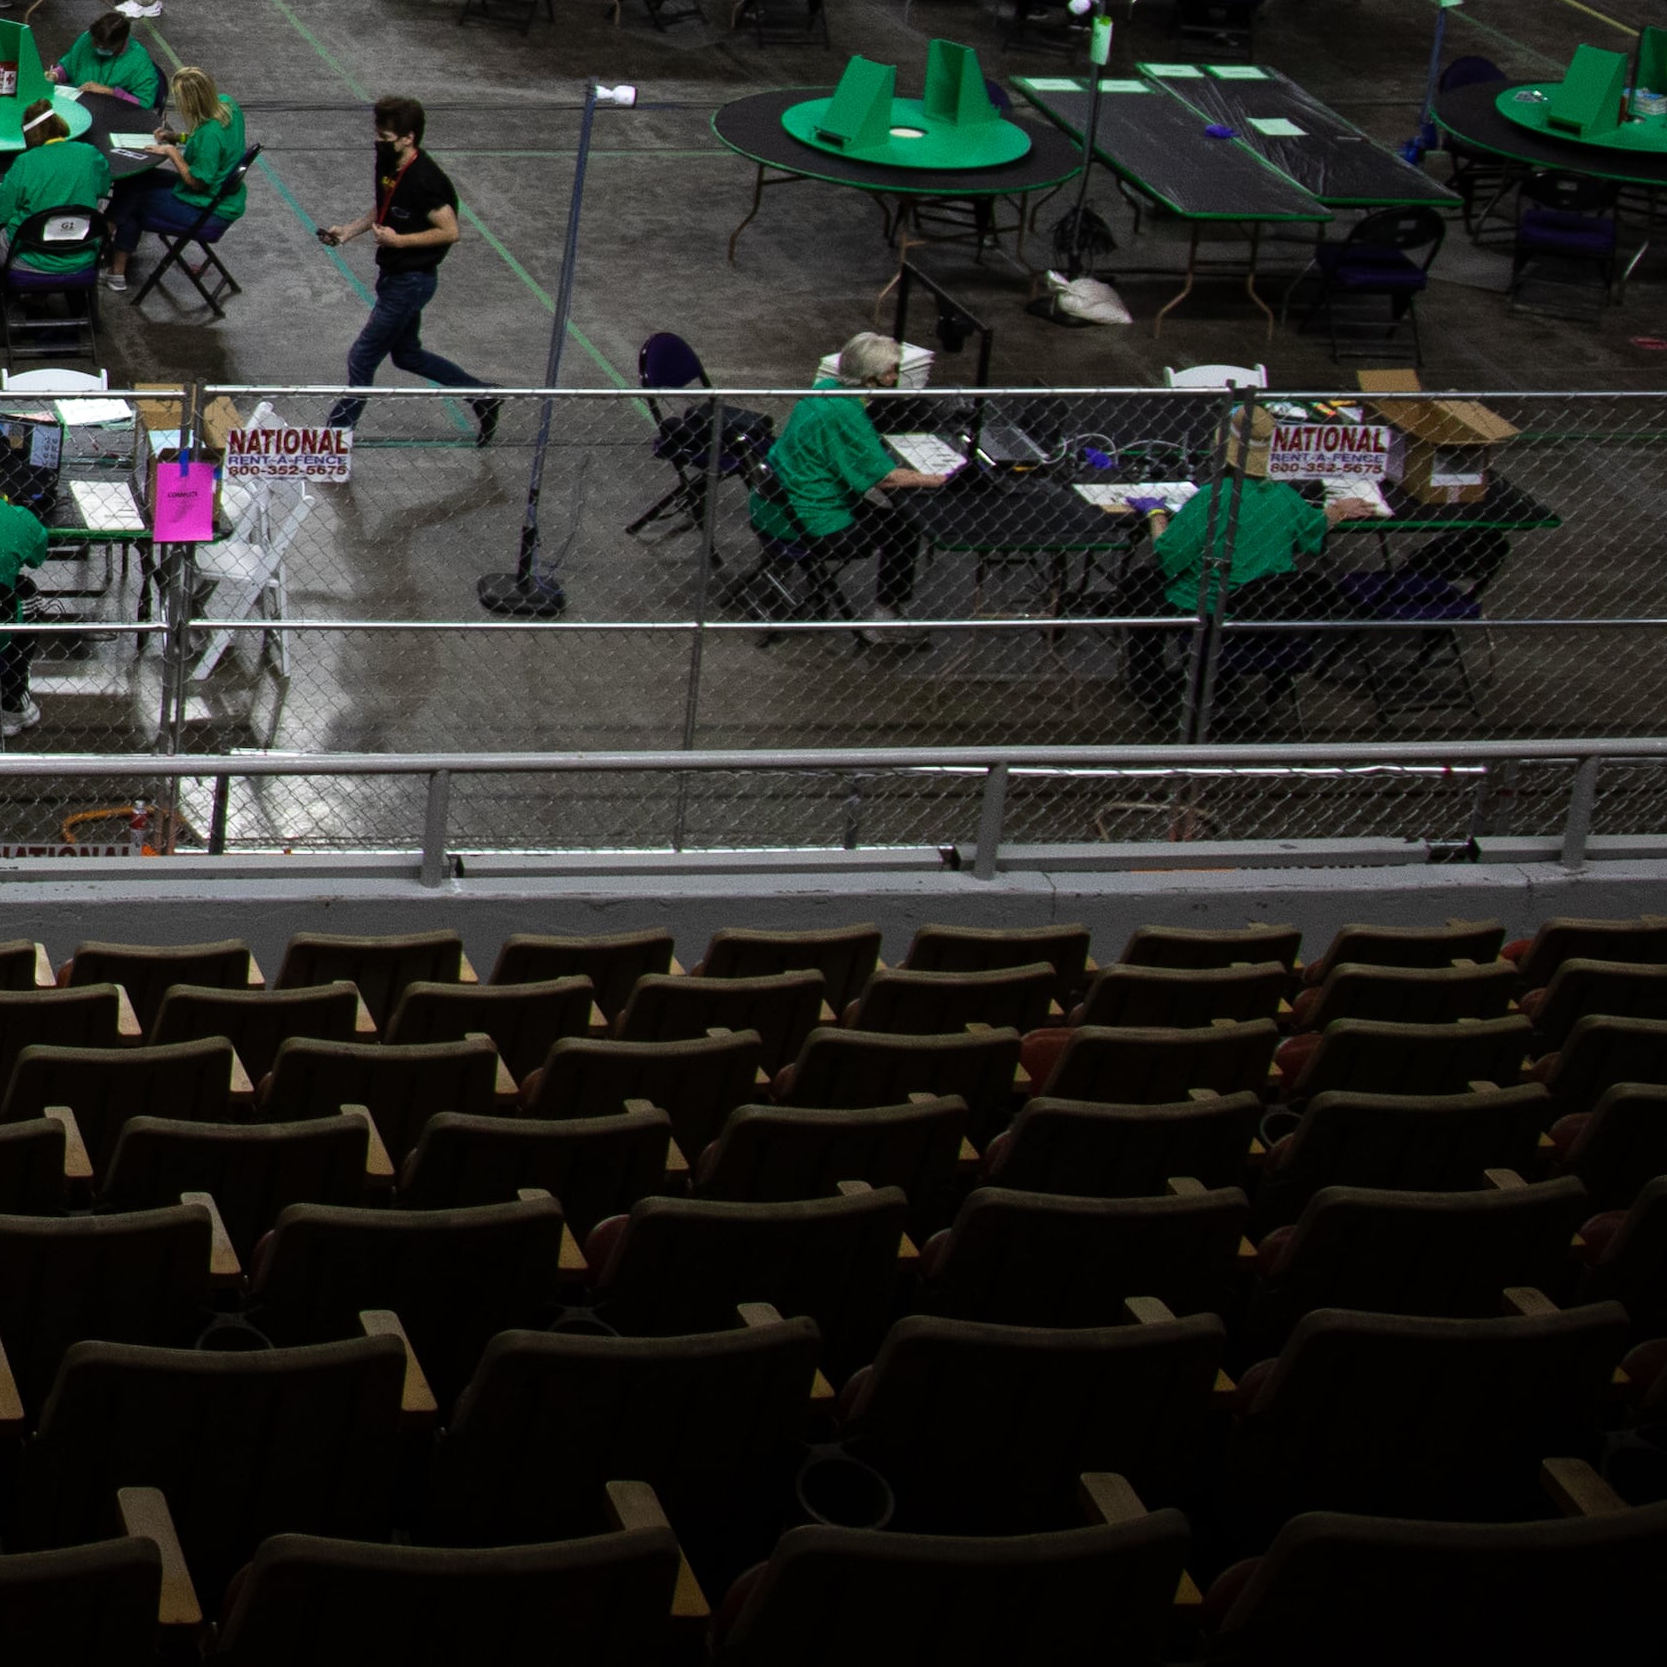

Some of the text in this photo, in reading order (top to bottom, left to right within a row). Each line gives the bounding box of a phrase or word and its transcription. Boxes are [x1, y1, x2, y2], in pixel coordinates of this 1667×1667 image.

[229, 429, 349, 455] NATIONAL
[1272, 427, 1386, 453] NATIONAL
[228, 455, 348, 465] RENT-A-FENCE
[1270, 453, 1384, 464] RENT-A-FENCE
[228, 465, 347, 476] 800-352-5675
[1269, 463, 1383, 475] 800-352-5675
